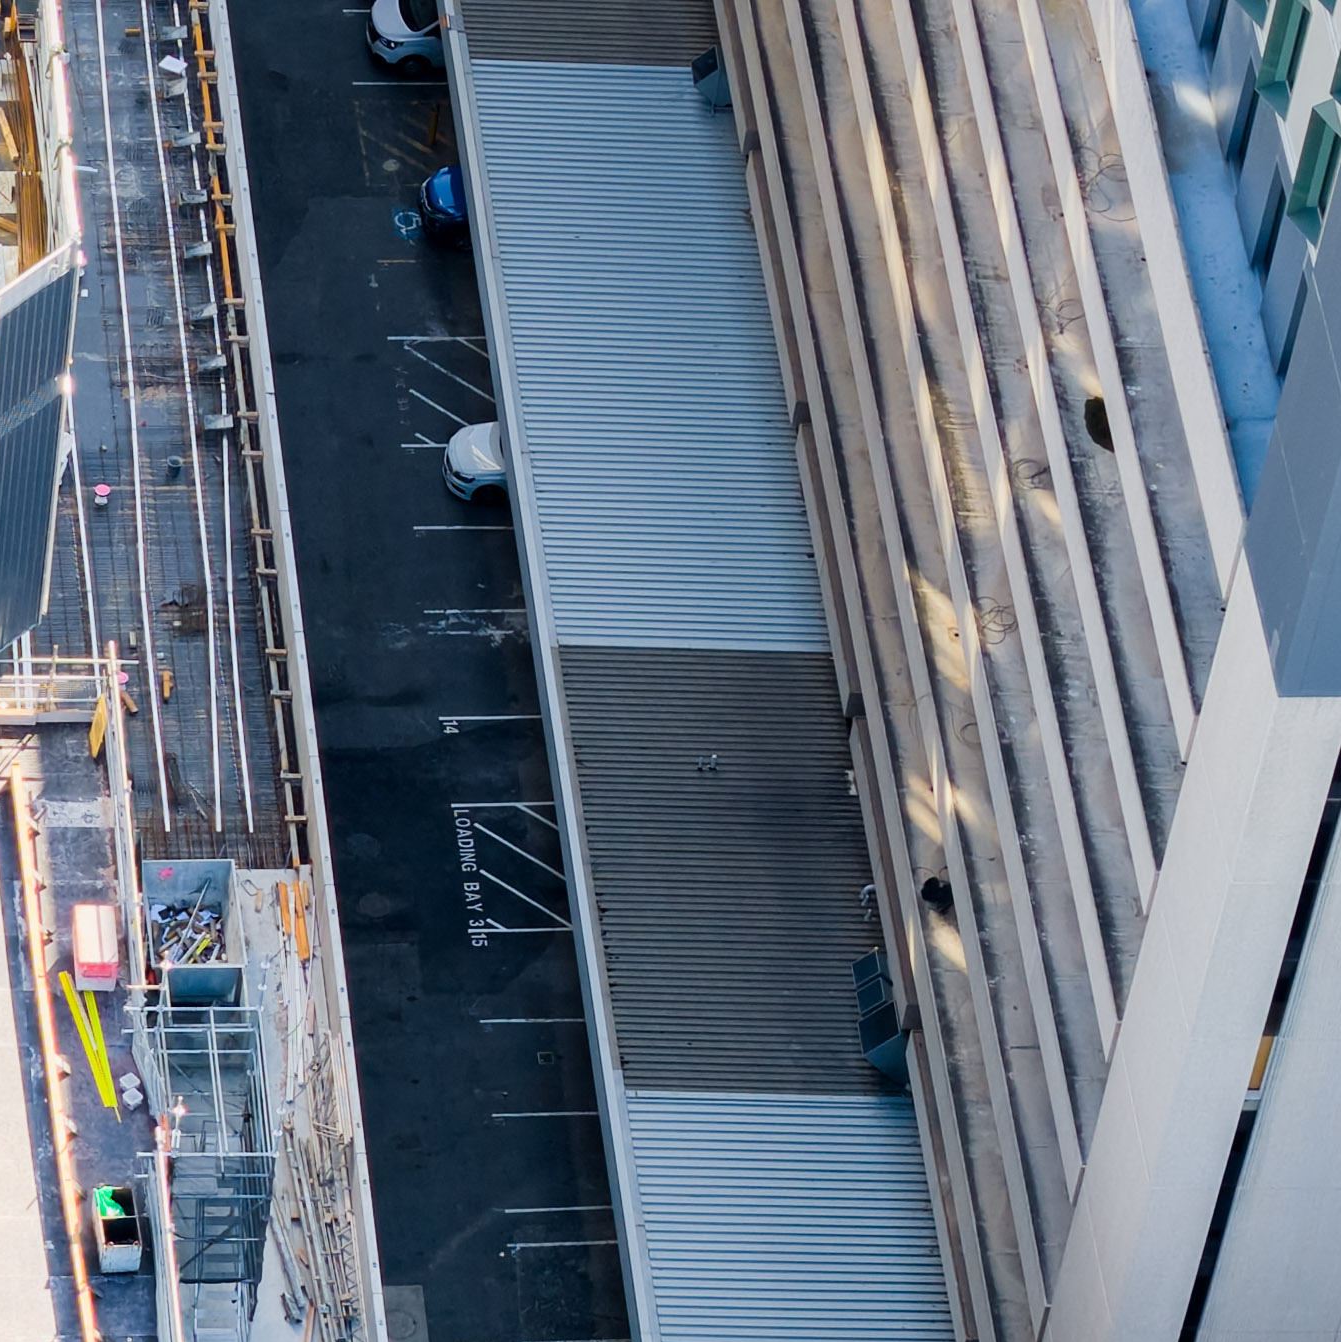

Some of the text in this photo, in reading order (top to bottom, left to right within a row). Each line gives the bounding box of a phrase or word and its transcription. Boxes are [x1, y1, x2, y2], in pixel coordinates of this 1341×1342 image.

[442, 719, 459, 735] 14
[453, 809, 484, 928] LOADING BAY 3
[470, 932, 488, 947] 15
